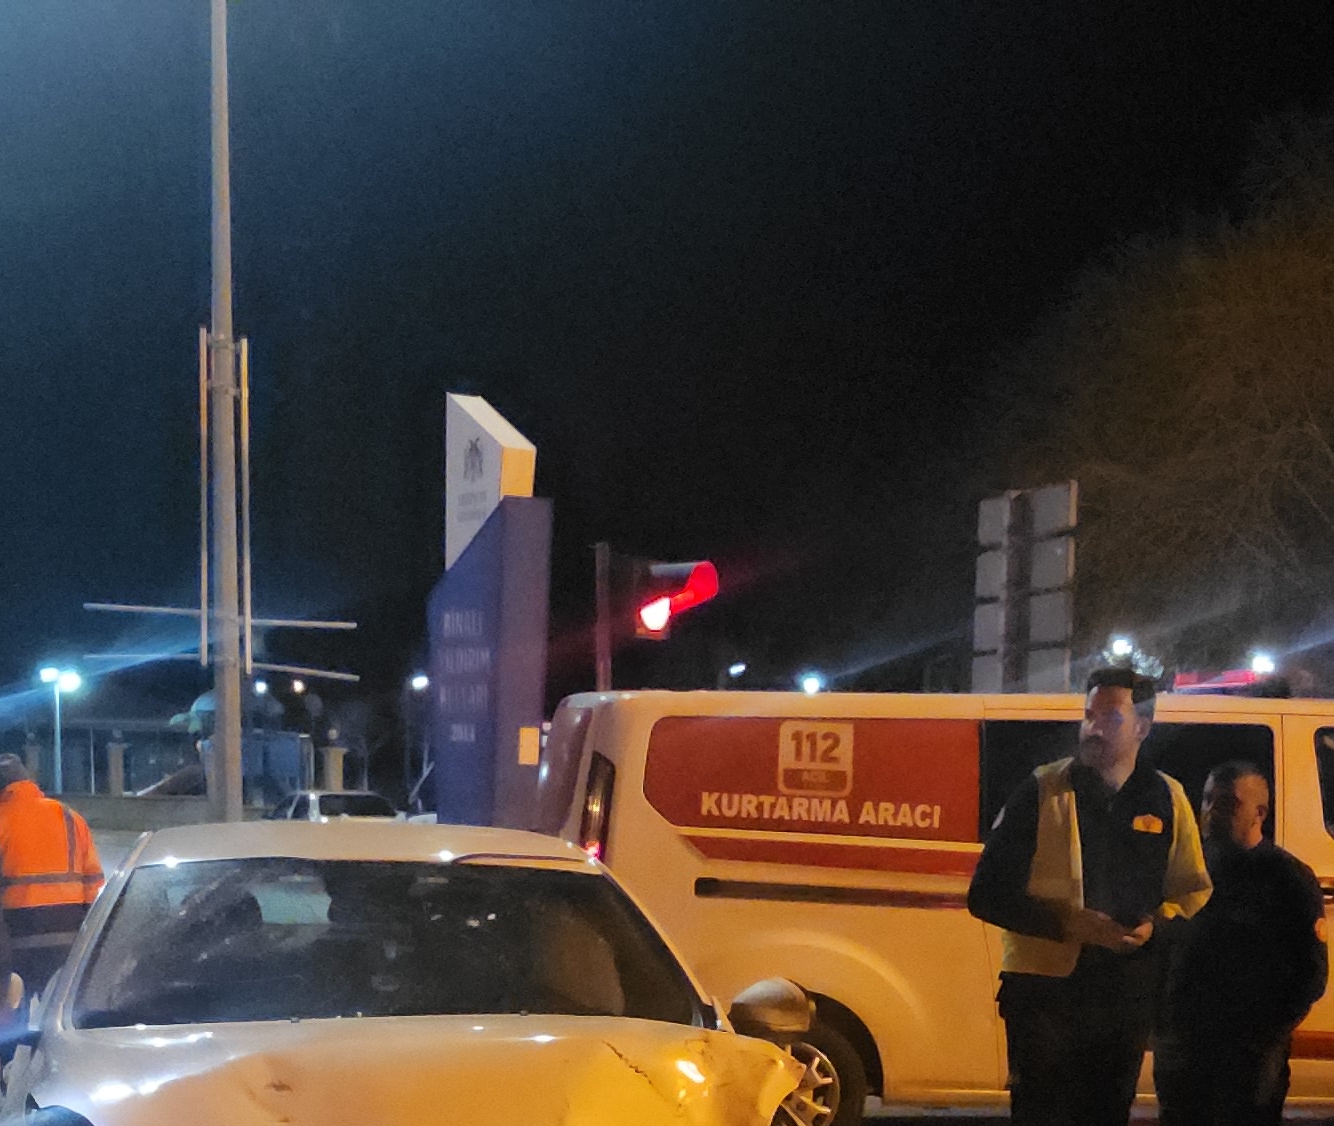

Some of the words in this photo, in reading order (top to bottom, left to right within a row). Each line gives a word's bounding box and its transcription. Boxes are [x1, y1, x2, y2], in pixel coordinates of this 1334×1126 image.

[791, 730, 841, 764] 112
[701, 791, 850, 824] KURTARMA
[858, 801, 941, 828] ARACI
